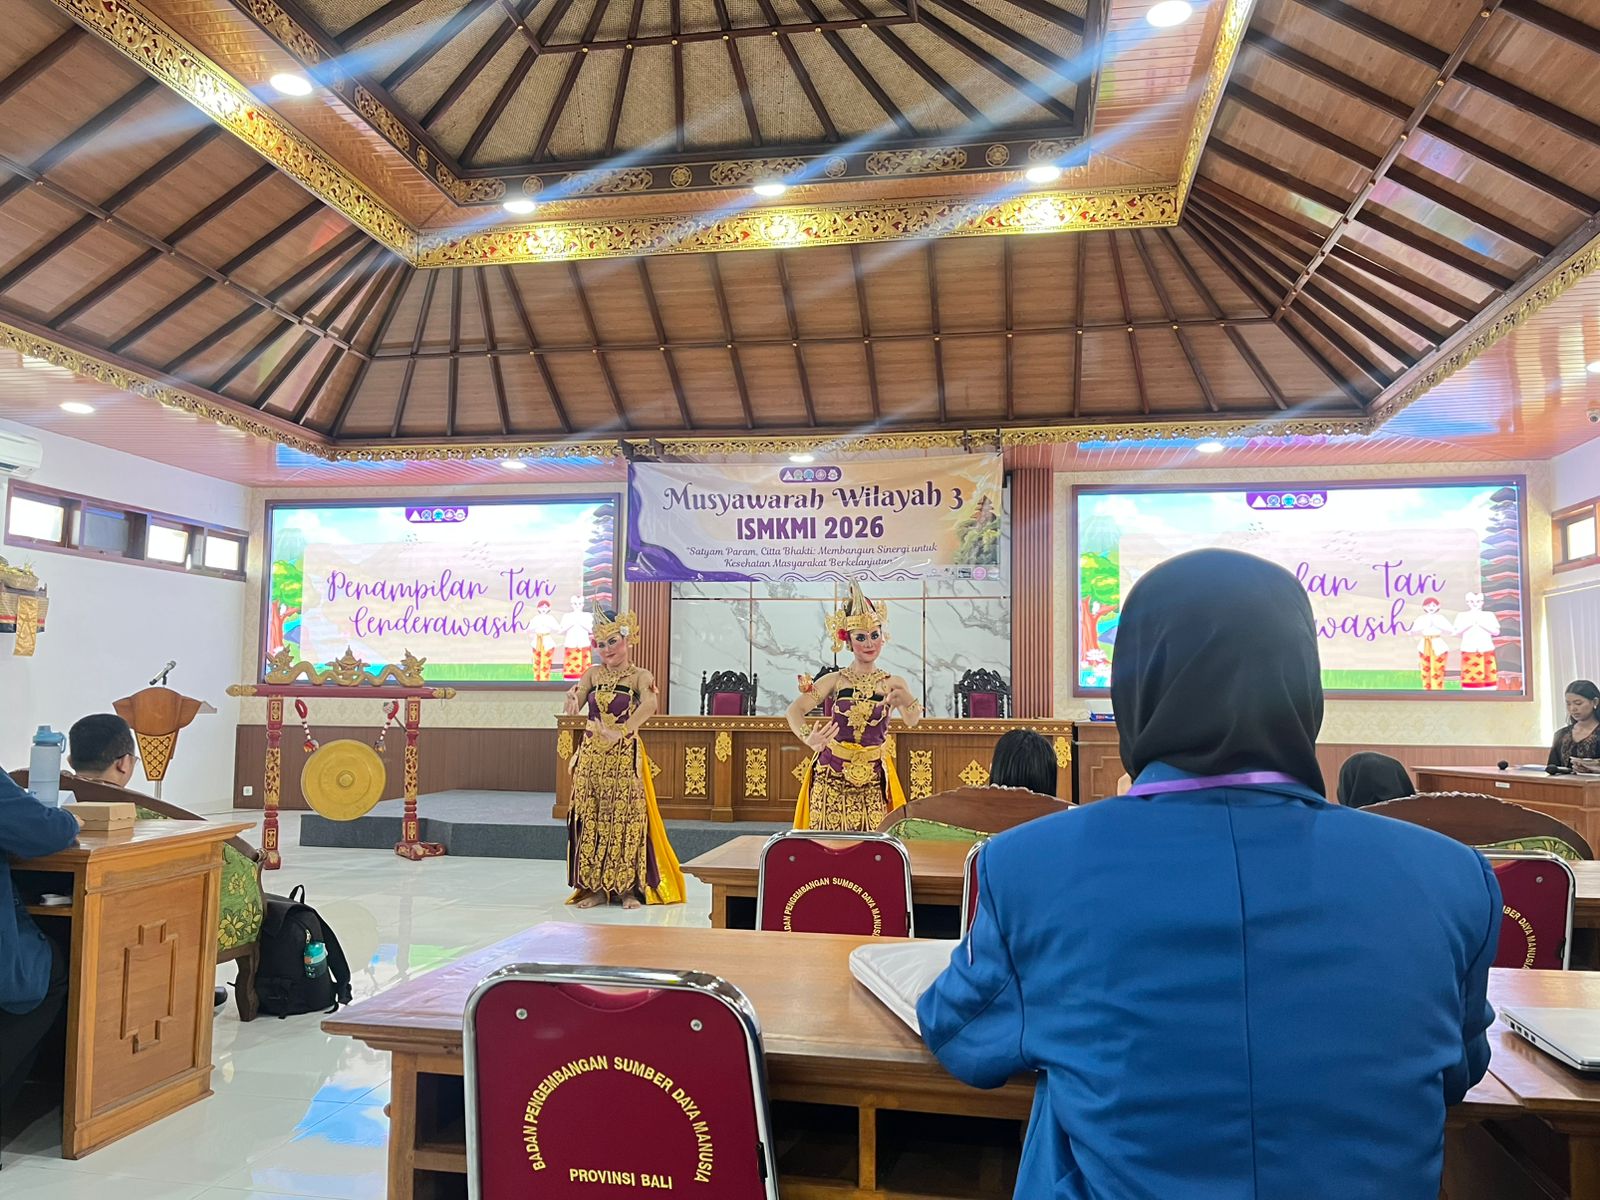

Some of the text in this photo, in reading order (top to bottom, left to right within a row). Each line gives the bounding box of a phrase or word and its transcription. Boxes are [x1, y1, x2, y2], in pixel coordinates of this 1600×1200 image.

[663, 481, 964, 517] Musyawarah Wilayah 3
[737, 515, 884, 541] ISMKMI 2026
[760, 546, 782, 556] Citta
[817, 544, 875, 557] Membangun
[876, 543, 910, 554] Sinergi
[911, 541, 937, 553] untuk
[723, 558, 770, 568] Kesehatan
[772, 557, 828, 571] Masyarakat
[327, 567, 557, 611] Penampilan Tari
[1372, 559, 1447, 599] Tari
[348, 600, 531, 639] Cenderawasih
[784, 877, 830, 915] PENGEMBANGAN
[832, 877, 863, 895] SUMBER
[861, 891, 877, 909] DAYA
[783, 915, 792, 933] DAN
[1503, 905, 1521, 920] BER
[1518, 917, 1534, 936] DAYA
[523, 1055, 714, 1183] BADAN PENGEMBANGAN SUMBER DAYA MANUSIA
[569, 1168, 673, 1190] PROVINSI BALI
